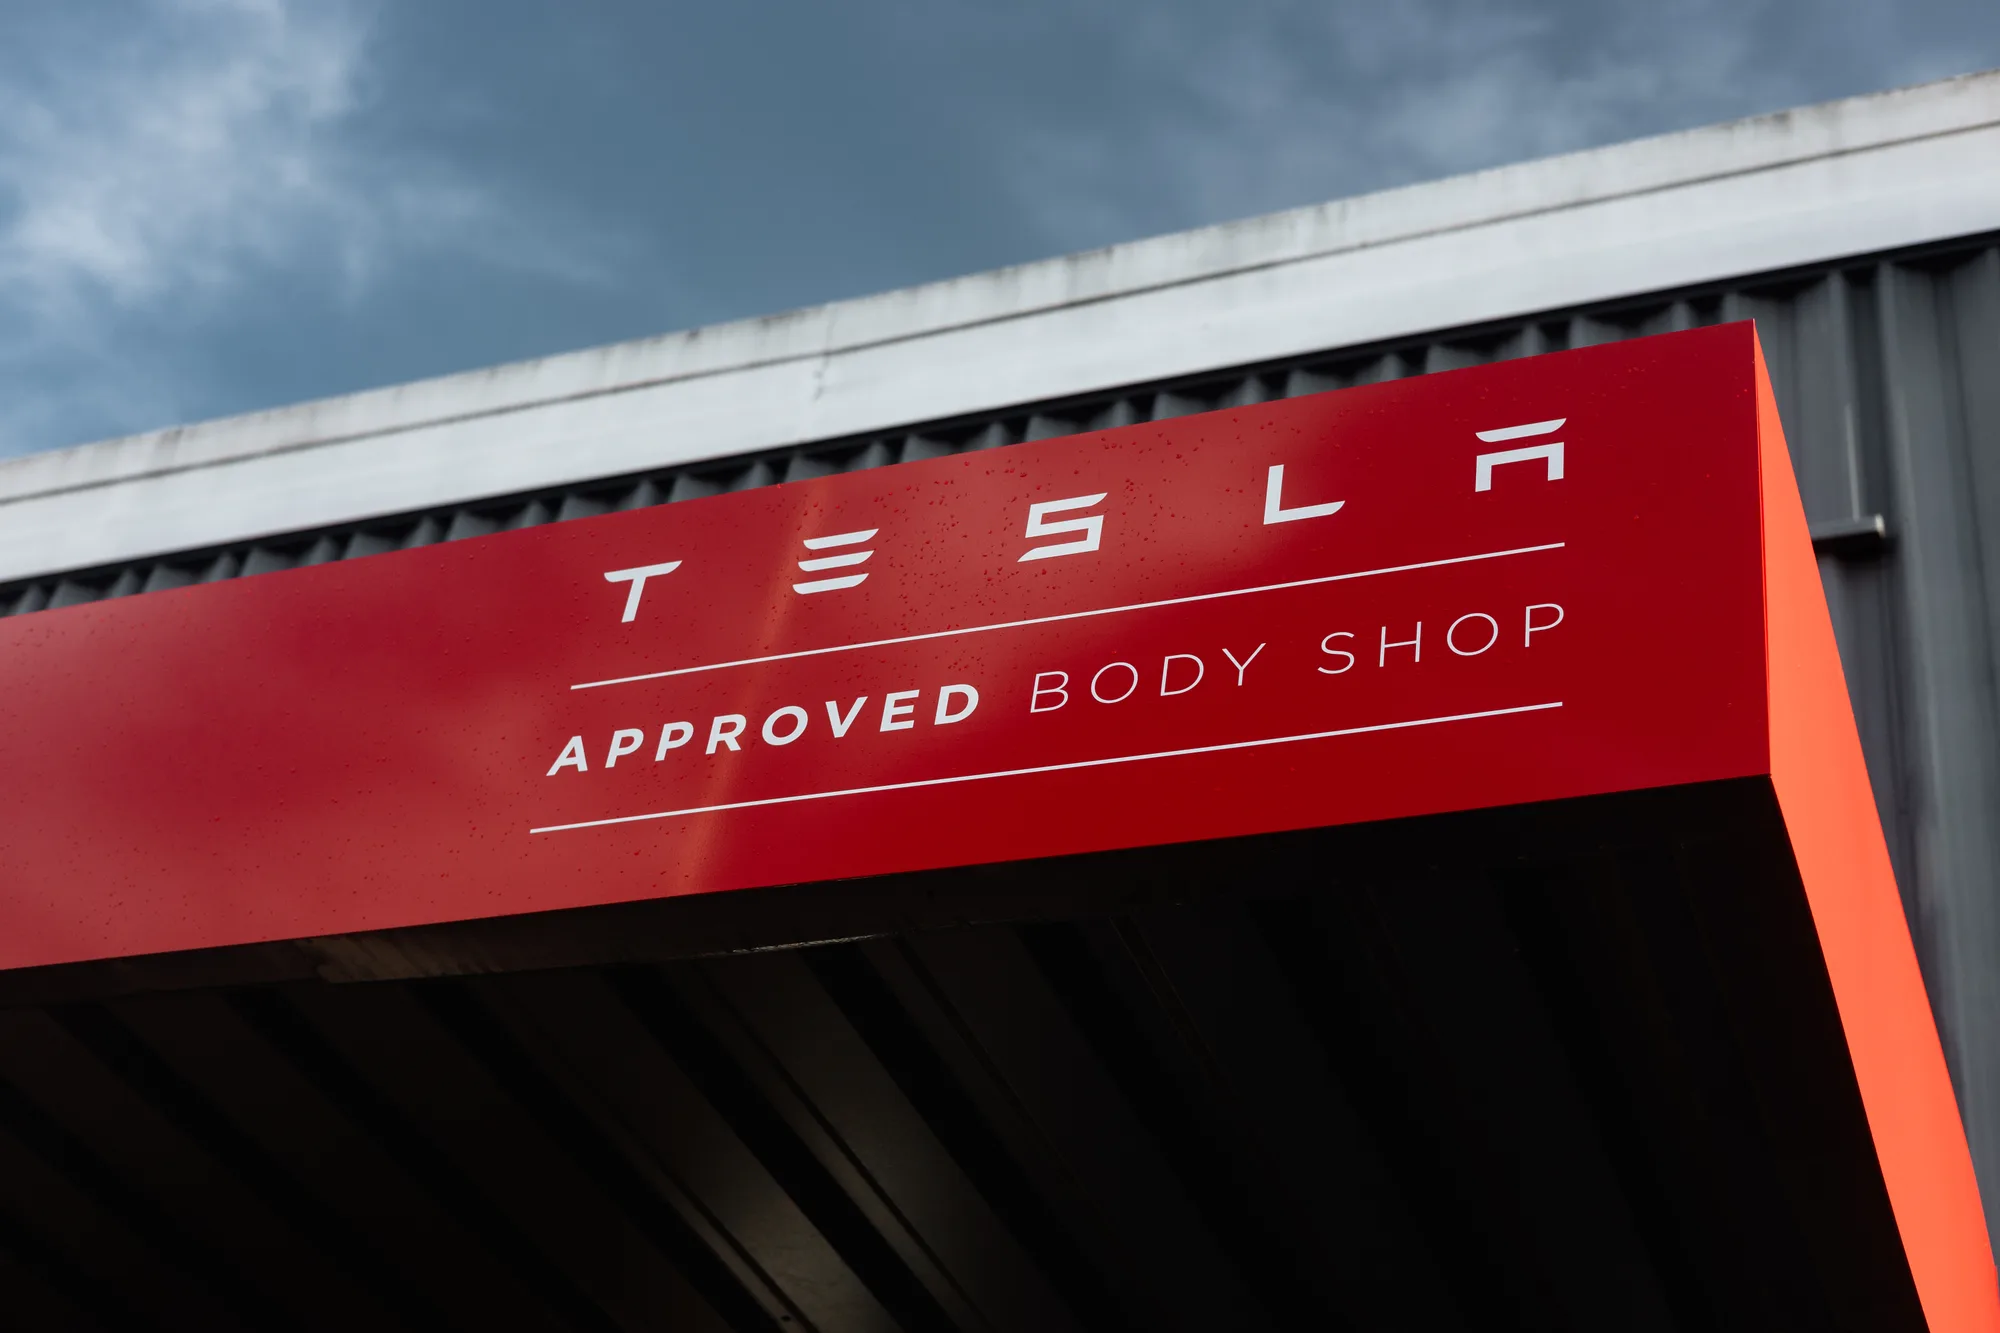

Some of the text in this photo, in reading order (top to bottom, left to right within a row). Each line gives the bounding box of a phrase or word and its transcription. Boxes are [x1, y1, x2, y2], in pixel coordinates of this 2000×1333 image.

[603, 417, 1567, 623] TESLA
[545, 603, 1566, 777] APPROVED BODY SHOP
